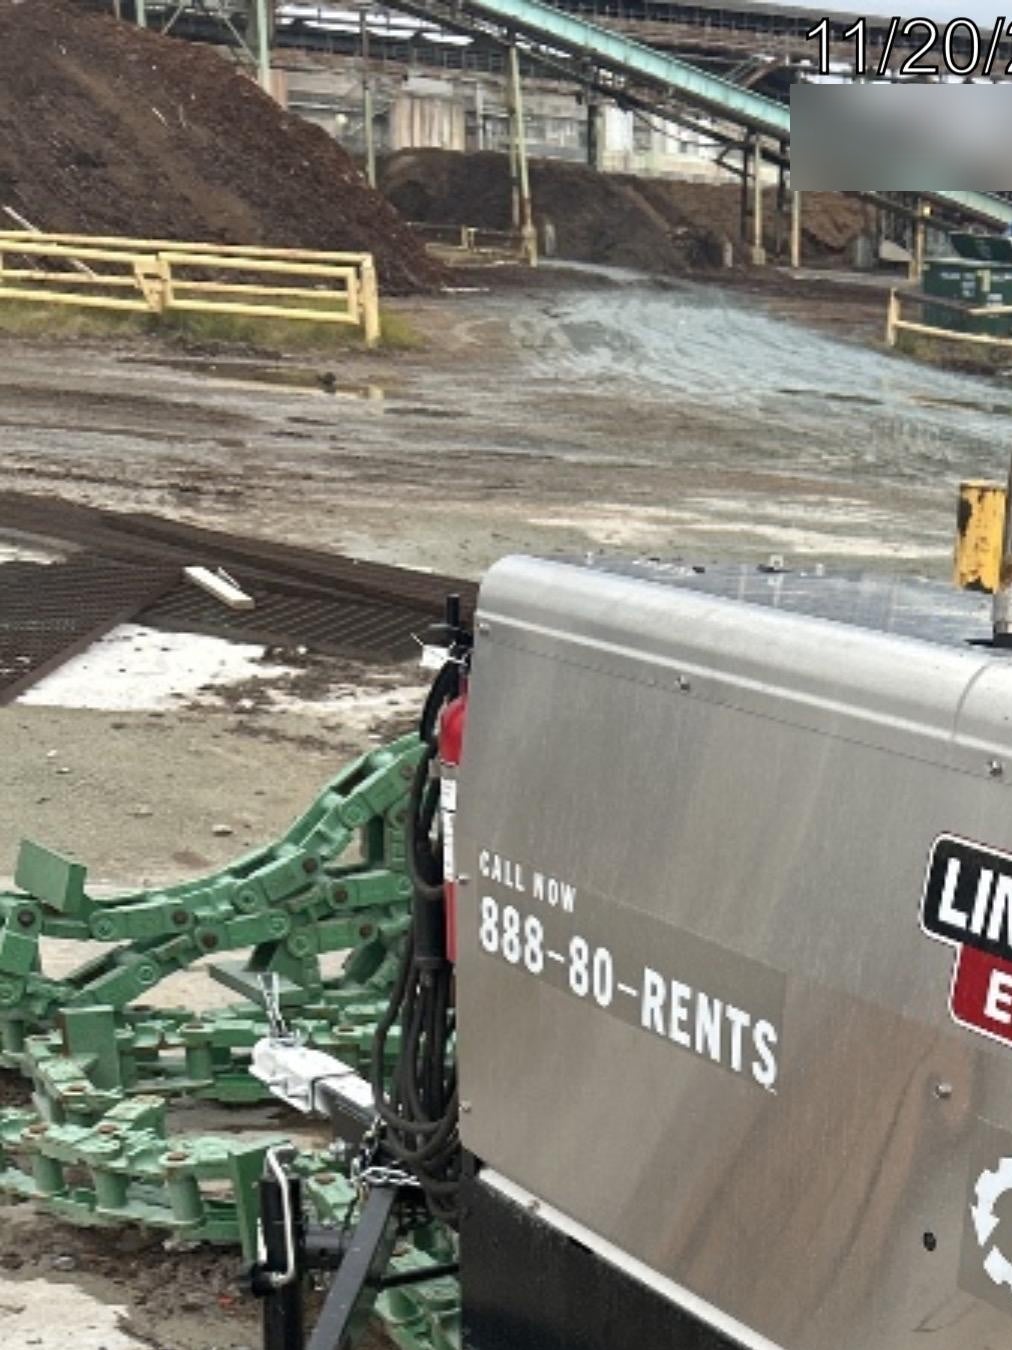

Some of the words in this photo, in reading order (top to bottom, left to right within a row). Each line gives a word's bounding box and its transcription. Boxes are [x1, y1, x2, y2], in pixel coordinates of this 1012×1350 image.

[479, 849, 525, 892] CALL
[533, 873, 577, 913] NOW
[479, 896, 778, 1088] 888-80-RENTS
